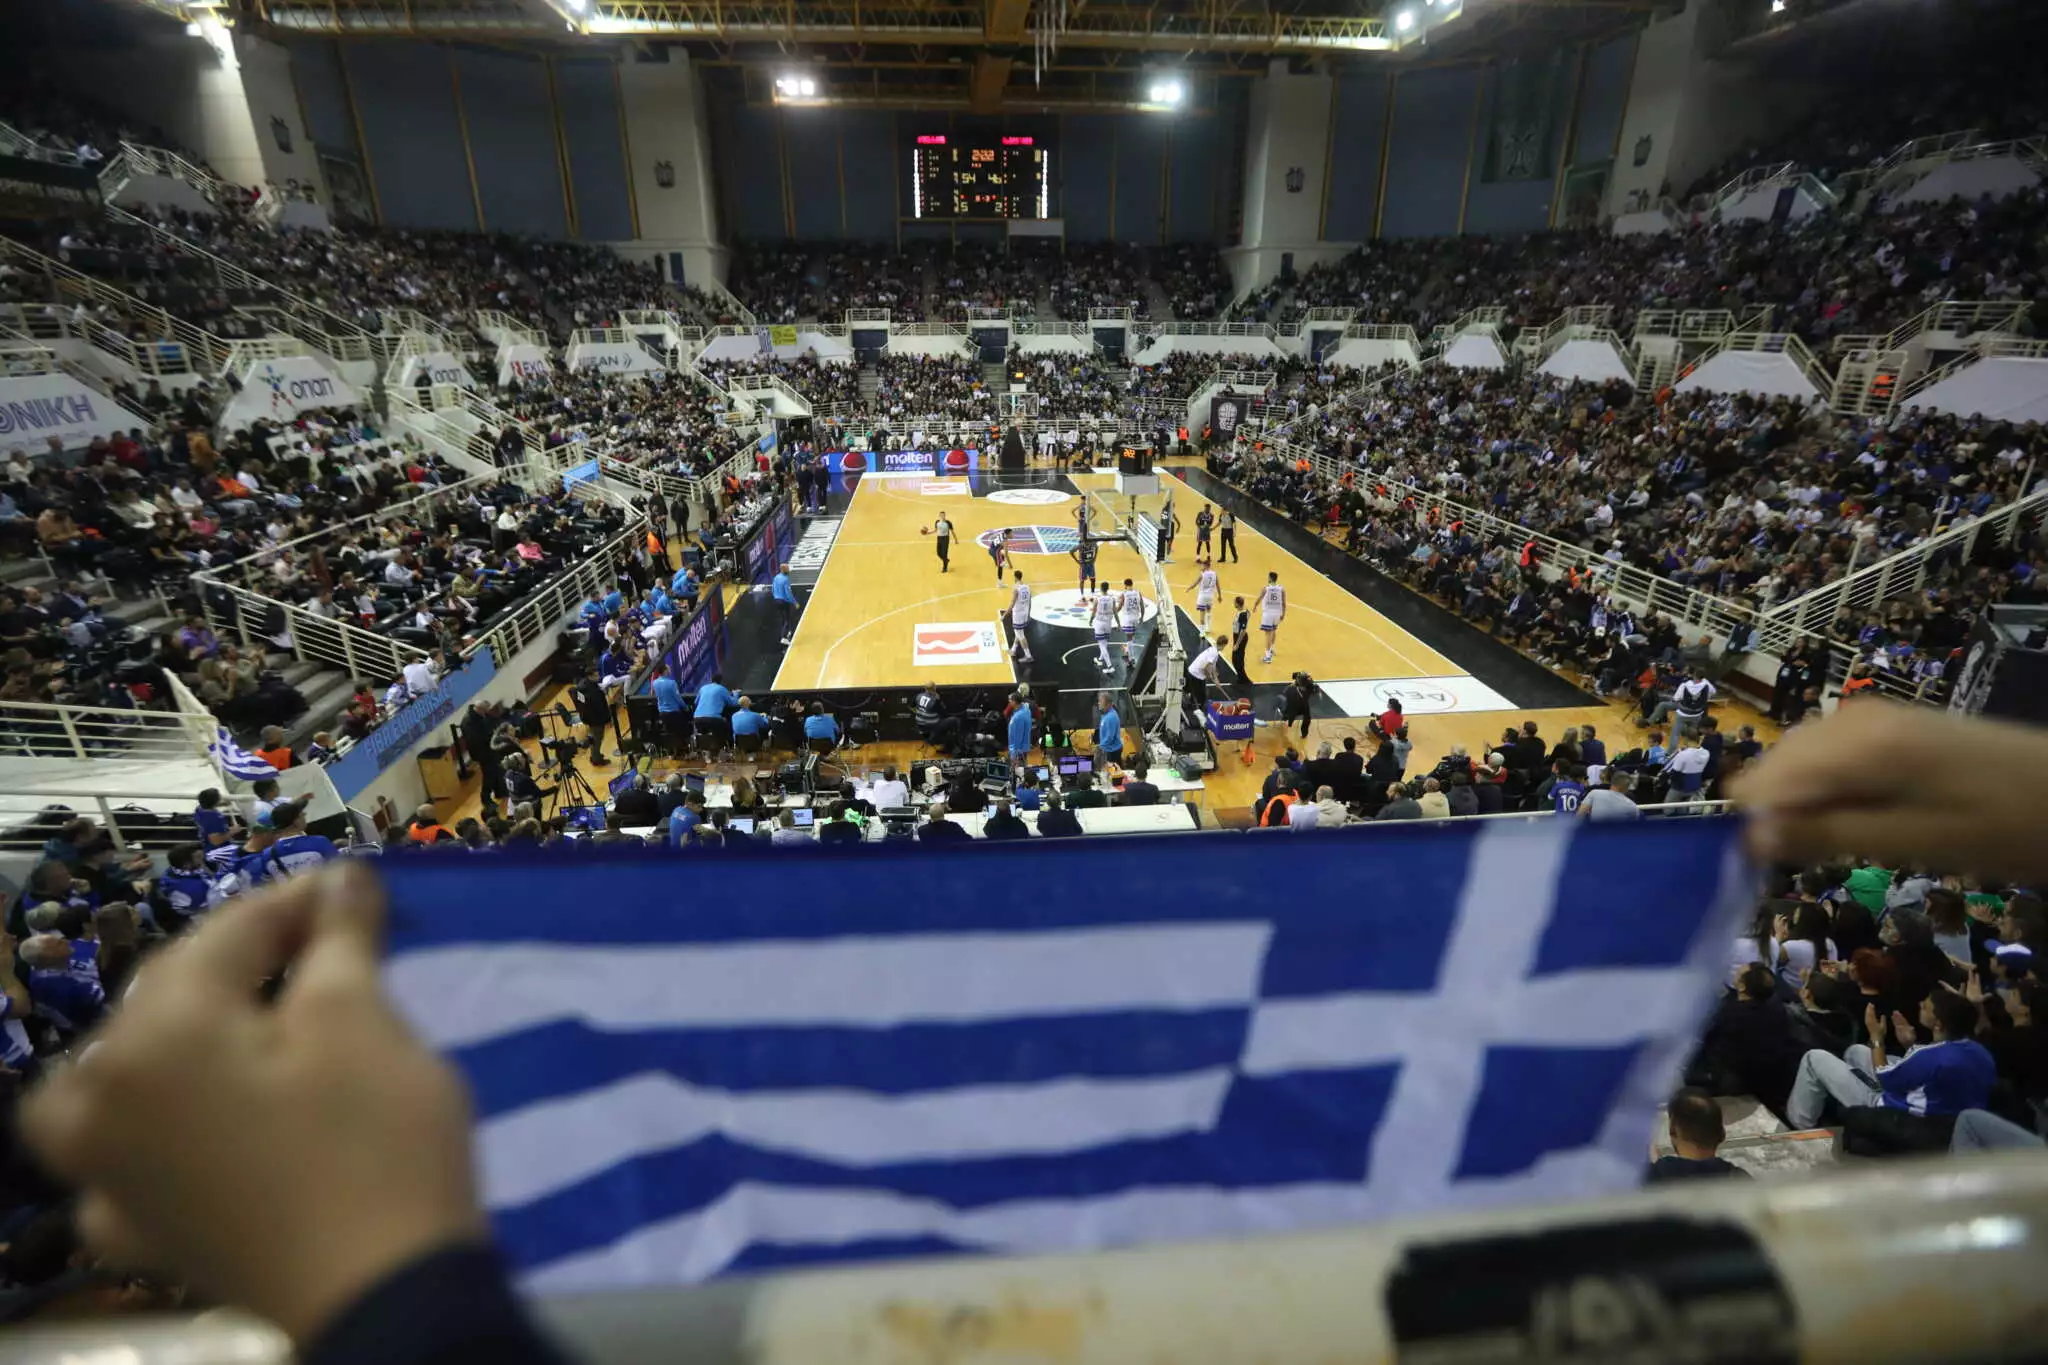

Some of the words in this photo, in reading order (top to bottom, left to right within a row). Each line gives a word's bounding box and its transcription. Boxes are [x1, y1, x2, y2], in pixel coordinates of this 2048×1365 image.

[961, 172, 977, 185] 54
[987, 172, 1003, 185] 46
[960, 201, 969, 213] 5
[884, 451, 933, 464] molten
[677, 615, 706, 667] molten
[1223, 723, 1250, 731] molten
[1560, 794, 1578, 812] 10
